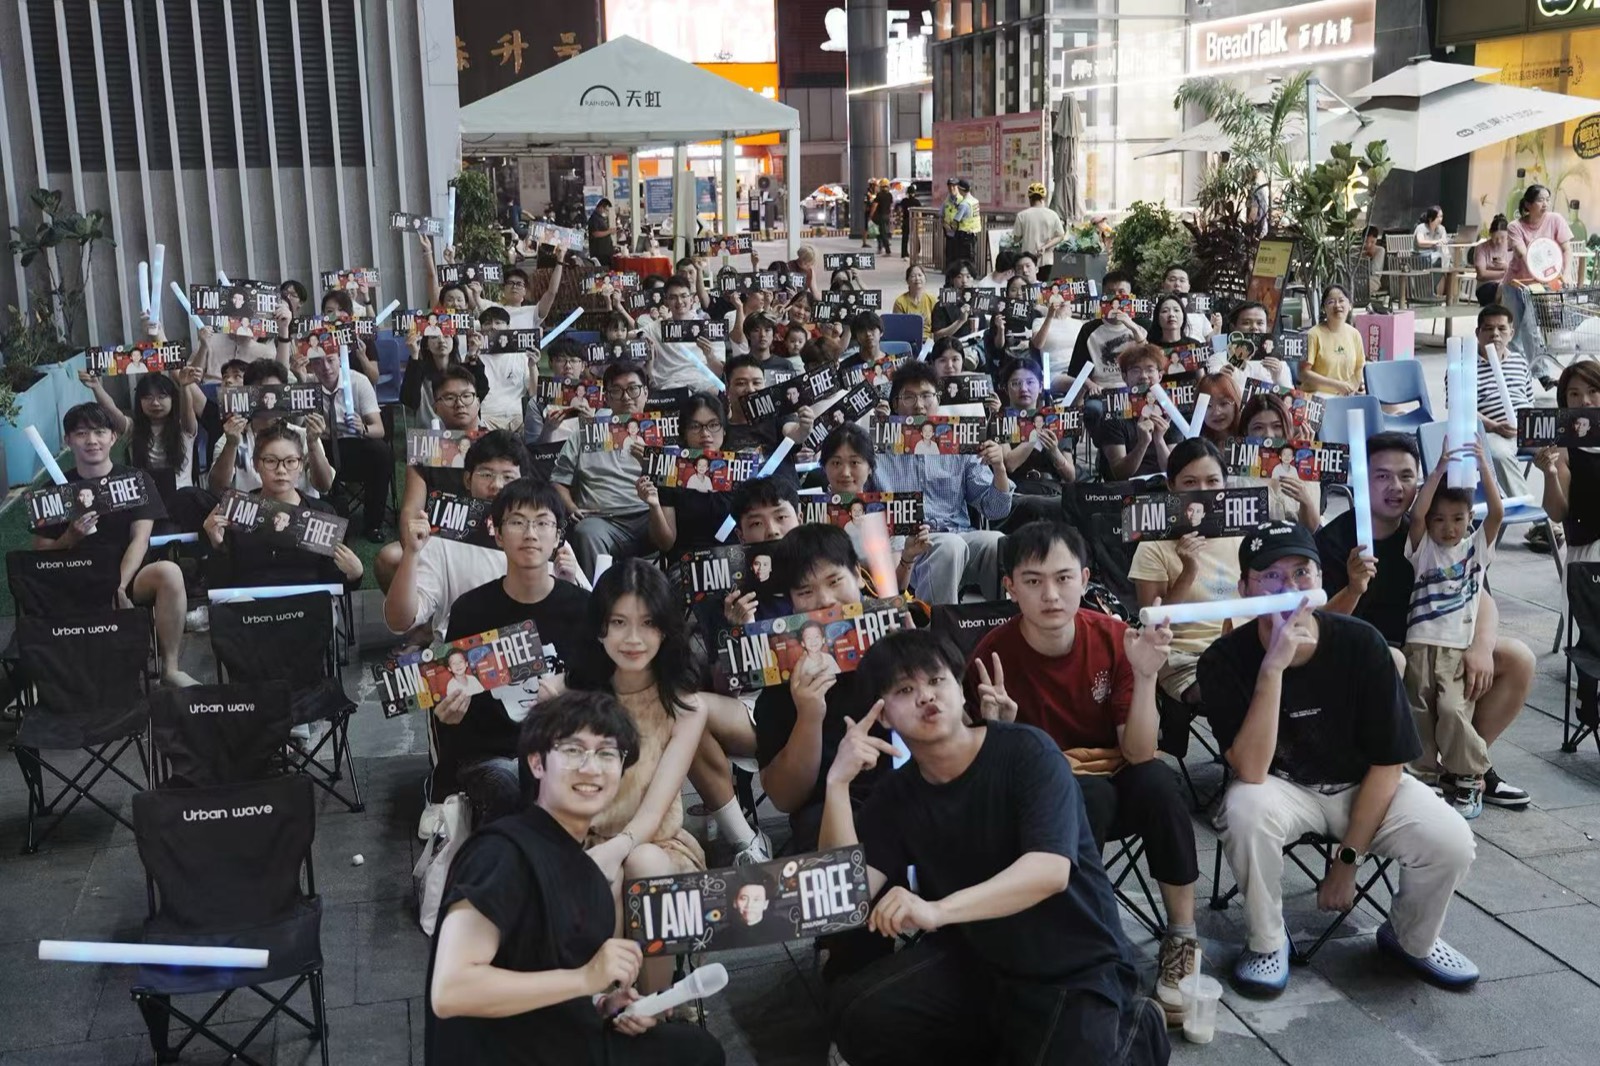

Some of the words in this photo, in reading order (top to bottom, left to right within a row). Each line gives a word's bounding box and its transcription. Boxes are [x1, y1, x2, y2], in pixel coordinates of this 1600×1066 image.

[1206, 17, 1289, 62] BreadTalk
[584, 100, 616, 108] RAINBOW
[625, 89, 662, 108] 天虹
[396, 216, 406, 228] AM
[427, 220, 440, 234] FREE
[701, 242, 710, 252] AM
[736, 236, 750, 249] FREE
[830, 257, 840, 268] AM
[859, 254, 872, 267] FREE
[328, 274, 339, 286] AM
[363, 270, 379, 283] FREE
[446, 269, 458, 281] AM
[484, 266, 500, 280] FREE
[586, 278, 595, 290] AM
[619, 274, 635, 286] FREE
[725, 278, 736, 290] AM
[760, 274, 775, 288] FREE
[792, 274, 804, 288] FREE
[830, 294, 840, 304] AM
[863, 294, 878, 306] FREE
[946, 292, 957, 304] AM
[1029, 287, 1041, 301] AM
[1069, 282, 1086, 295] FREE
[202, 292, 220, 310] AM
[634, 294, 646, 308] AM
[978, 298, 990, 310] AM
[1088, 300, 1100, 314] AM
[1131, 298, 1148, 313] FREE
[1196, 296, 1210, 310] FREE
[216, 316, 229, 326] AM
[818, 306, 831, 319] AM
[310, 320, 322, 330] AM
[355, 320, 373, 334] FREE
[402, 314, 416, 330] AM
[450, 314, 470, 330] FREE
[670, 324, 682, 338] AM
[708, 323, 724, 338] FREE
[331, 328, 353, 346] FREE
[517, 333, 536, 348] FREE
[592, 346, 604, 362] AM
[631, 342, 647, 358] FREE
[1192, 346, 1210, 363] FREE
[1284, 338, 1303, 356] FREE
[97, 350, 114, 370] AM
[157, 346, 181, 364] FREE
[547, 381, 562, 398] AM
[755, 394, 776, 416] AM
[809, 367, 835, 396] FREE
[970, 380, 990, 398] FREE
[231, 392, 250, 413] AM
[290, 388, 316, 410] FREE
[1113, 392, 1130, 412] AM
[1172, 386, 1194, 404] FREE
[813, 423, 830, 444] AM
[849, 386, 874, 413] FREE
[1304, 400, 1322, 423] FREE
[592, 424, 610, 444] AM
[656, 416, 680, 438] FREE
[1002, 416, 1018, 436] AM
[1059, 412, 1080, 430] FREE
[1533, 416, 1556, 440] AM
[882, 422, 902, 444] AM
[953, 422, 980, 445] FREE
[420, 436, 440, 458] AM
[1238, 444, 1260, 467] AM
[1314, 448, 1343, 472] FREE
[655, 454, 677, 476] AM
[726, 460, 754, 482] FREE
[42, 493, 65, 516] AM
[108, 476, 141, 504] FREE
[1085, 494, 1108, 502] Urban
[440, 502, 470, 532] AM
[806, 502, 828, 524] AM
[886, 500, 918, 525] FREE
[1141, 503, 1167, 532] AM
[1225, 497, 1259, 528] FREE
[232, 500, 260, 526] AM
[303, 517, 338, 548] FREE
[36, 560, 64, 570] Urban
[66, 558, 93, 568] wave
[703, 558, 732, 592] AM
[242, 614, 274, 624] Urban
[276, 610, 305, 622] wave
[958, 618, 986, 629] Urban
[988, 616, 1012, 626] wav
[52, 626, 85, 636] Urban
[88, 623, 119, 634] wave
[739, 633, 773, 671] AM
[394, 663, 426, 699] AM
[491, 630, 534, 670] FREE
[189, 703, 224, 714] Urban
[227, 702, 256, 713] wave
[182, 807, 228, 822] Urban
[232, 804, 274, 818] wave
[642, 894, 654, 940] I
[661, 889, 704, 940] AM
[798, 862, 856, 920] FREE
